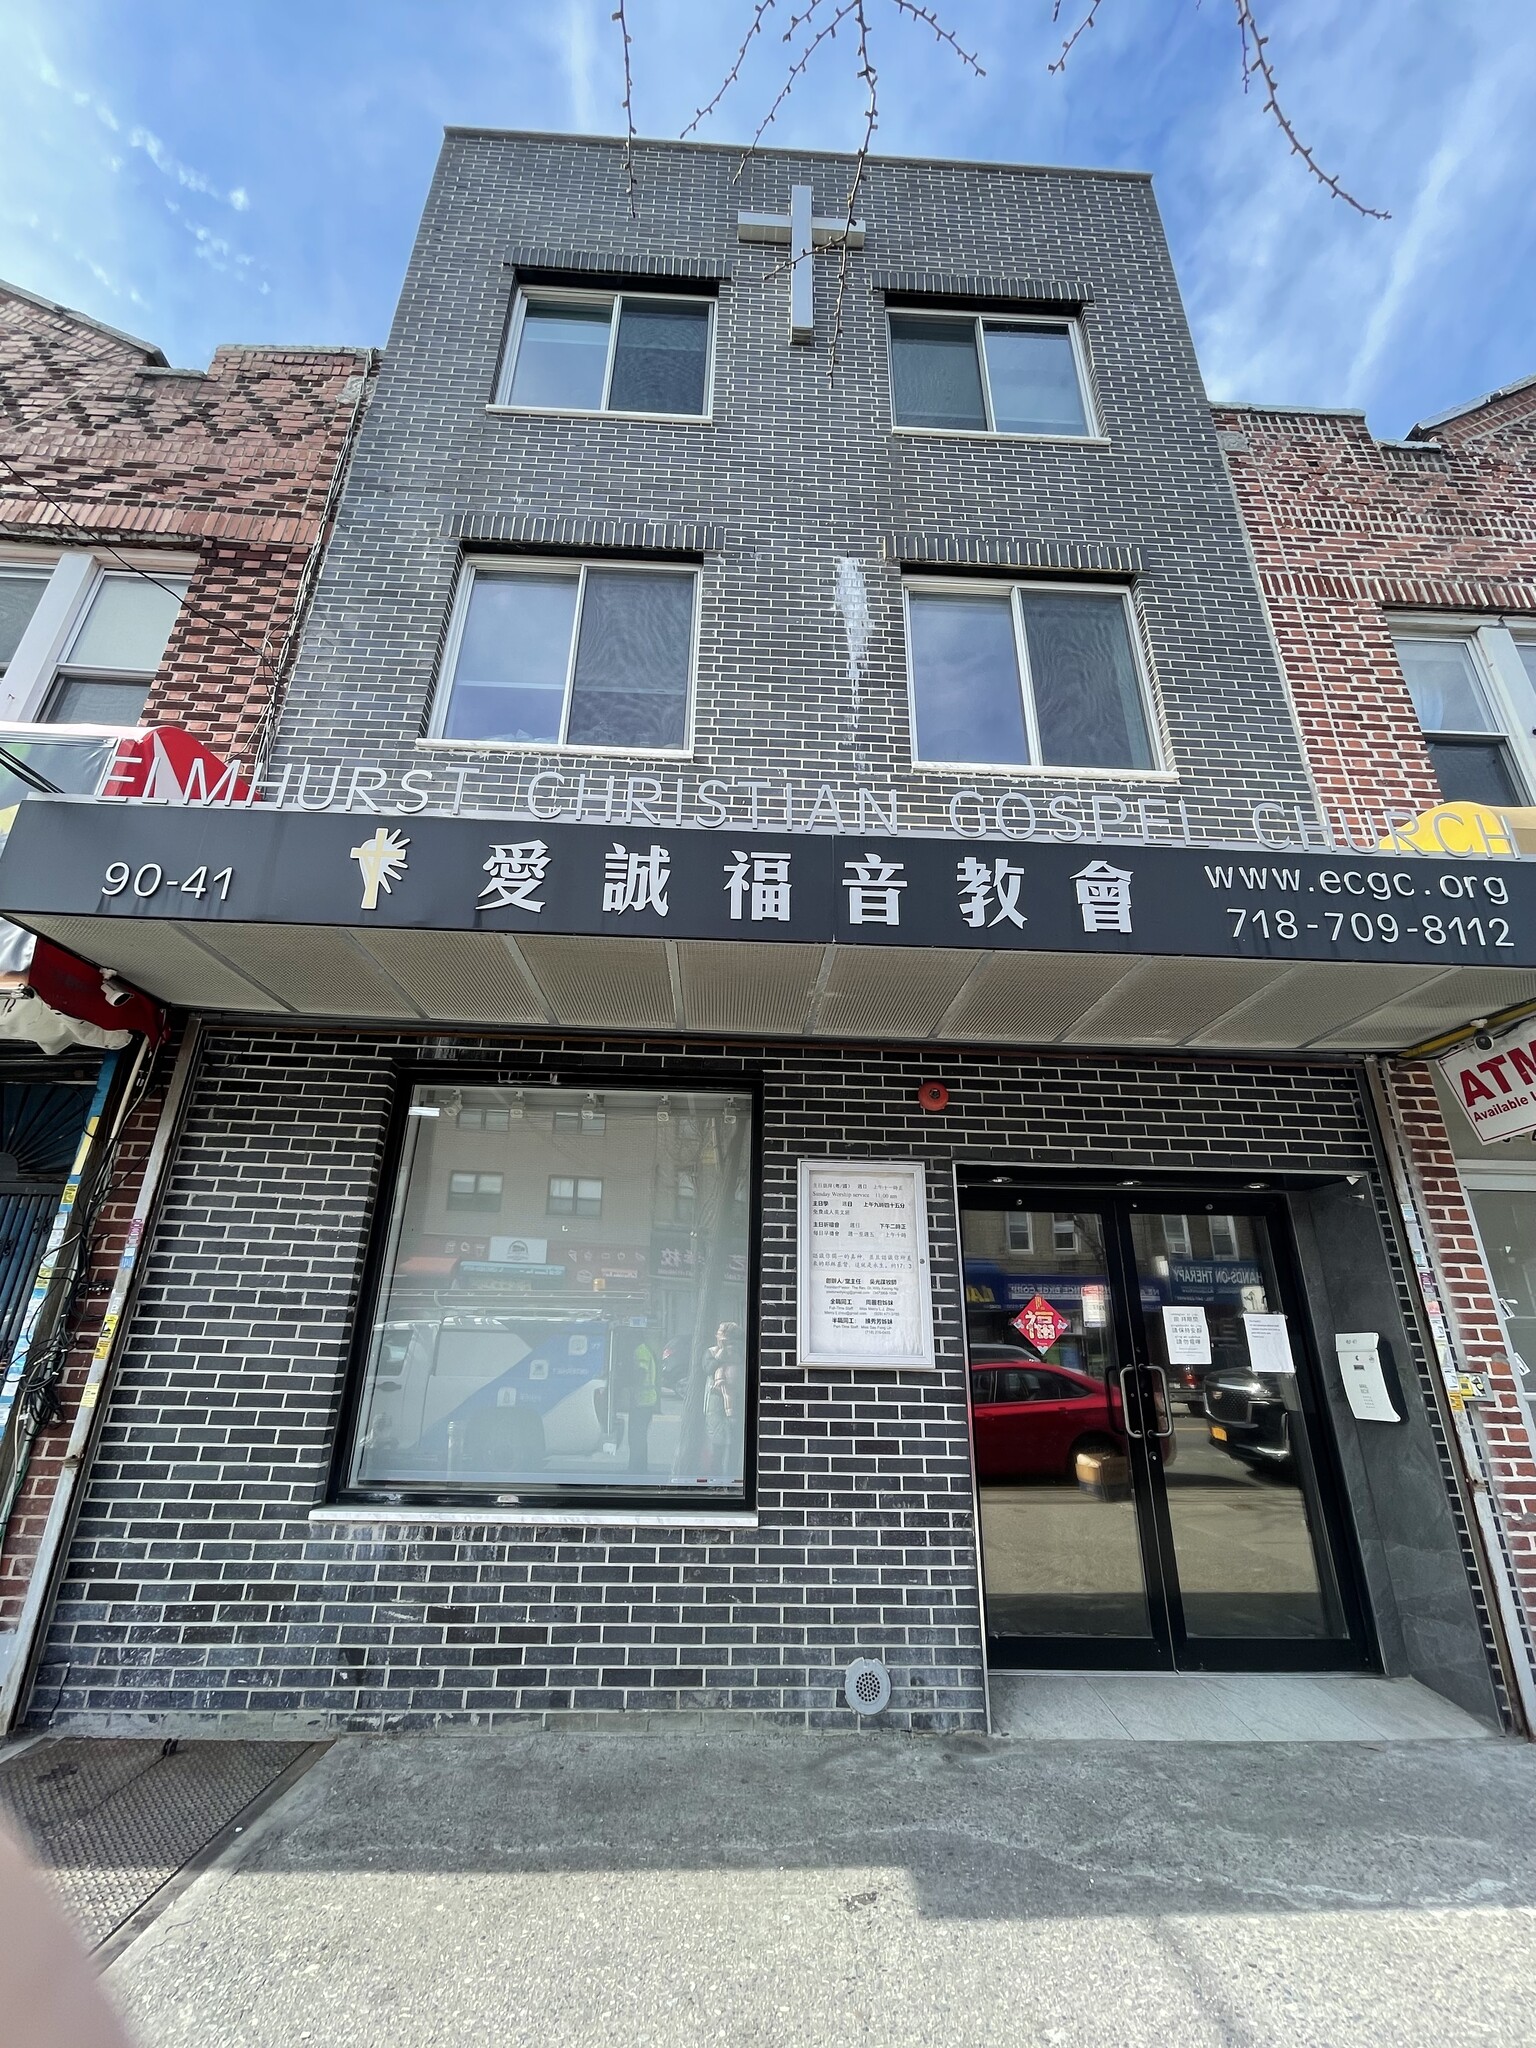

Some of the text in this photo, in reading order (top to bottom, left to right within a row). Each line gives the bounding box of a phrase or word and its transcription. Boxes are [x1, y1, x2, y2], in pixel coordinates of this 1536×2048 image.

[96, 754, 1521, 860] ELMHURST CHRISTIAN GOSPEL CHURCH
[101, 860, 235, 902] 90-41
[480, 838, 1135, 934] 愛誠福音教會
[1204, 862, 1511, 905] www.ecgc.org
[1226, 907, 1516, 949] 718-709-8112
[1459, 1038, 1536, 1108] ATM
[1473, 1095, 1529, 1123] Available
[832, 1191, 852, 1199] Worship
[1025, 1310, 1056, 1340] 福
